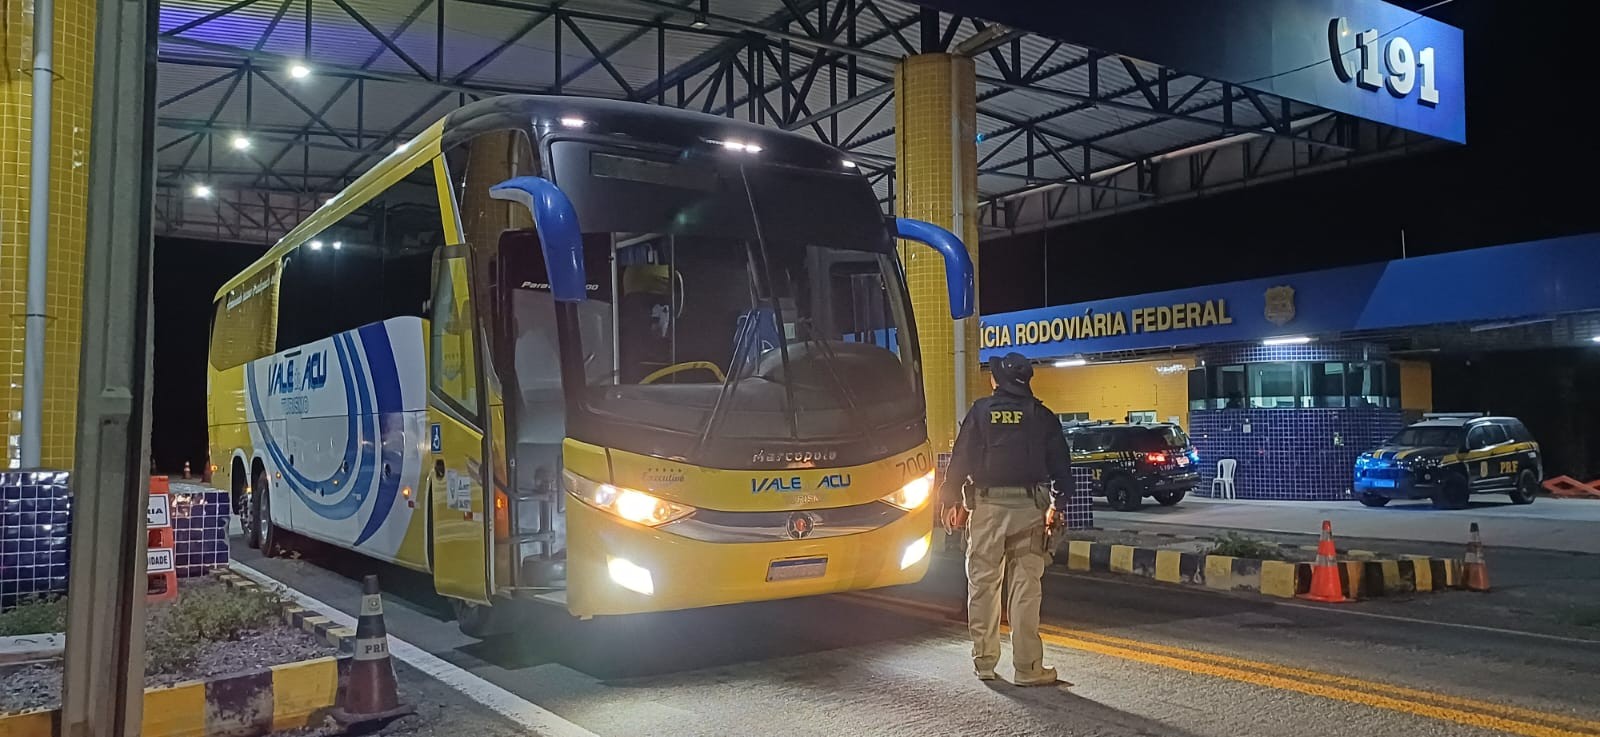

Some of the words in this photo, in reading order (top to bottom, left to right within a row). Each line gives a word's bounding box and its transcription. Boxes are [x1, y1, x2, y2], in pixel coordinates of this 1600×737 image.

[1355, 28, 1440, 107] 191
[521, 281, 551, 290] Para
[1015, 307, 1126, 345] RODOVIÁRIA
[1131, 298, 1232, 333] FEDERAL
[268, 359, 294, 397] VALE
[990, 410, 1024, 424] PRF
[752, 450, 837, 463] Marcopolo
[1500, 460, 1519, 474] PRF
[751, 476, 802, 492] VALE
[365, 643, 386, 654] PRF
